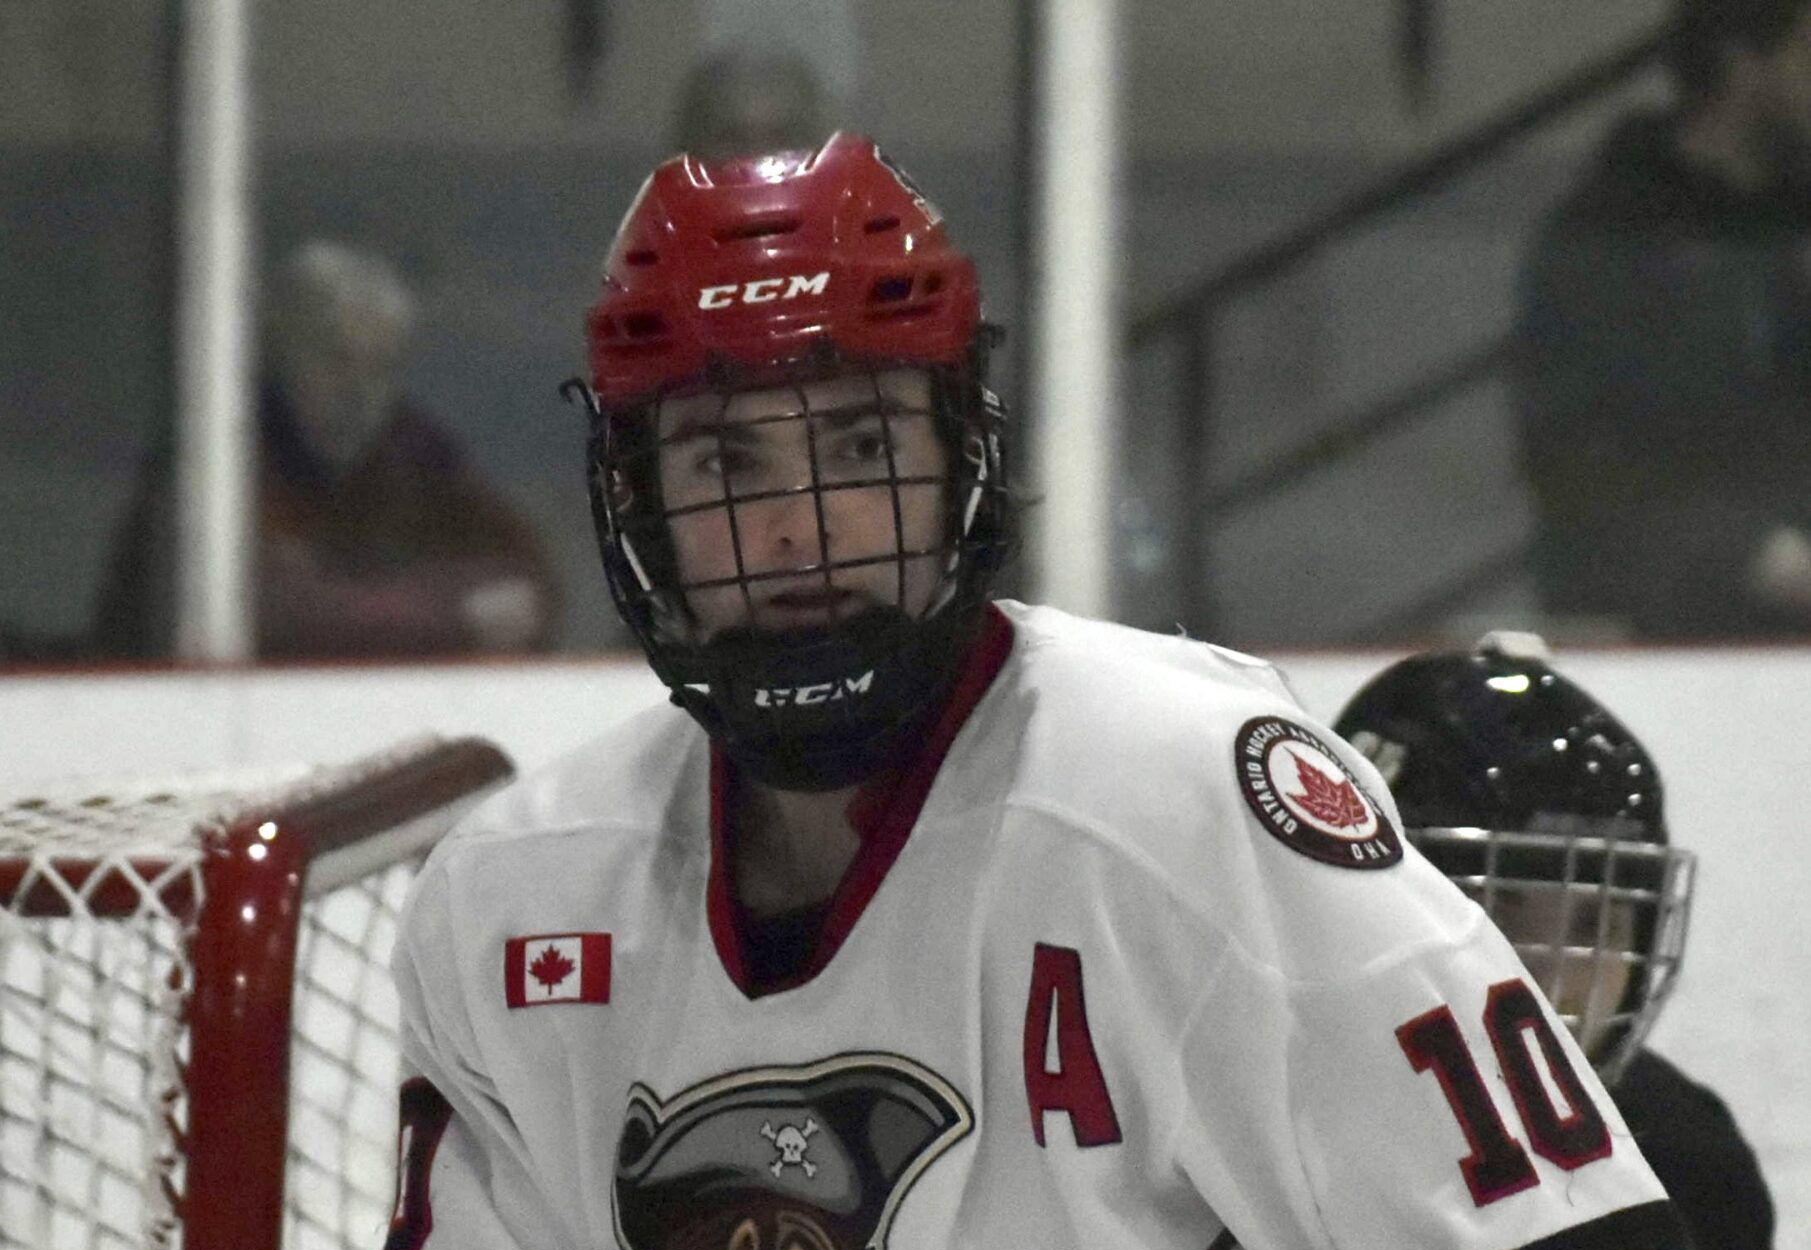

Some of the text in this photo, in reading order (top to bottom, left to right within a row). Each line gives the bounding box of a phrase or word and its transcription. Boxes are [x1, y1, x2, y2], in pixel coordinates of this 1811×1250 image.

[698, 272, 831, 310] CCM
[1246, 722, 1298, 835] ONTARIO HOCKEY
[1351, 839, 1391, 861] OHA
[1023, 941, 1123, 1148] A
[1394, 977, 1613, 1208] 10
